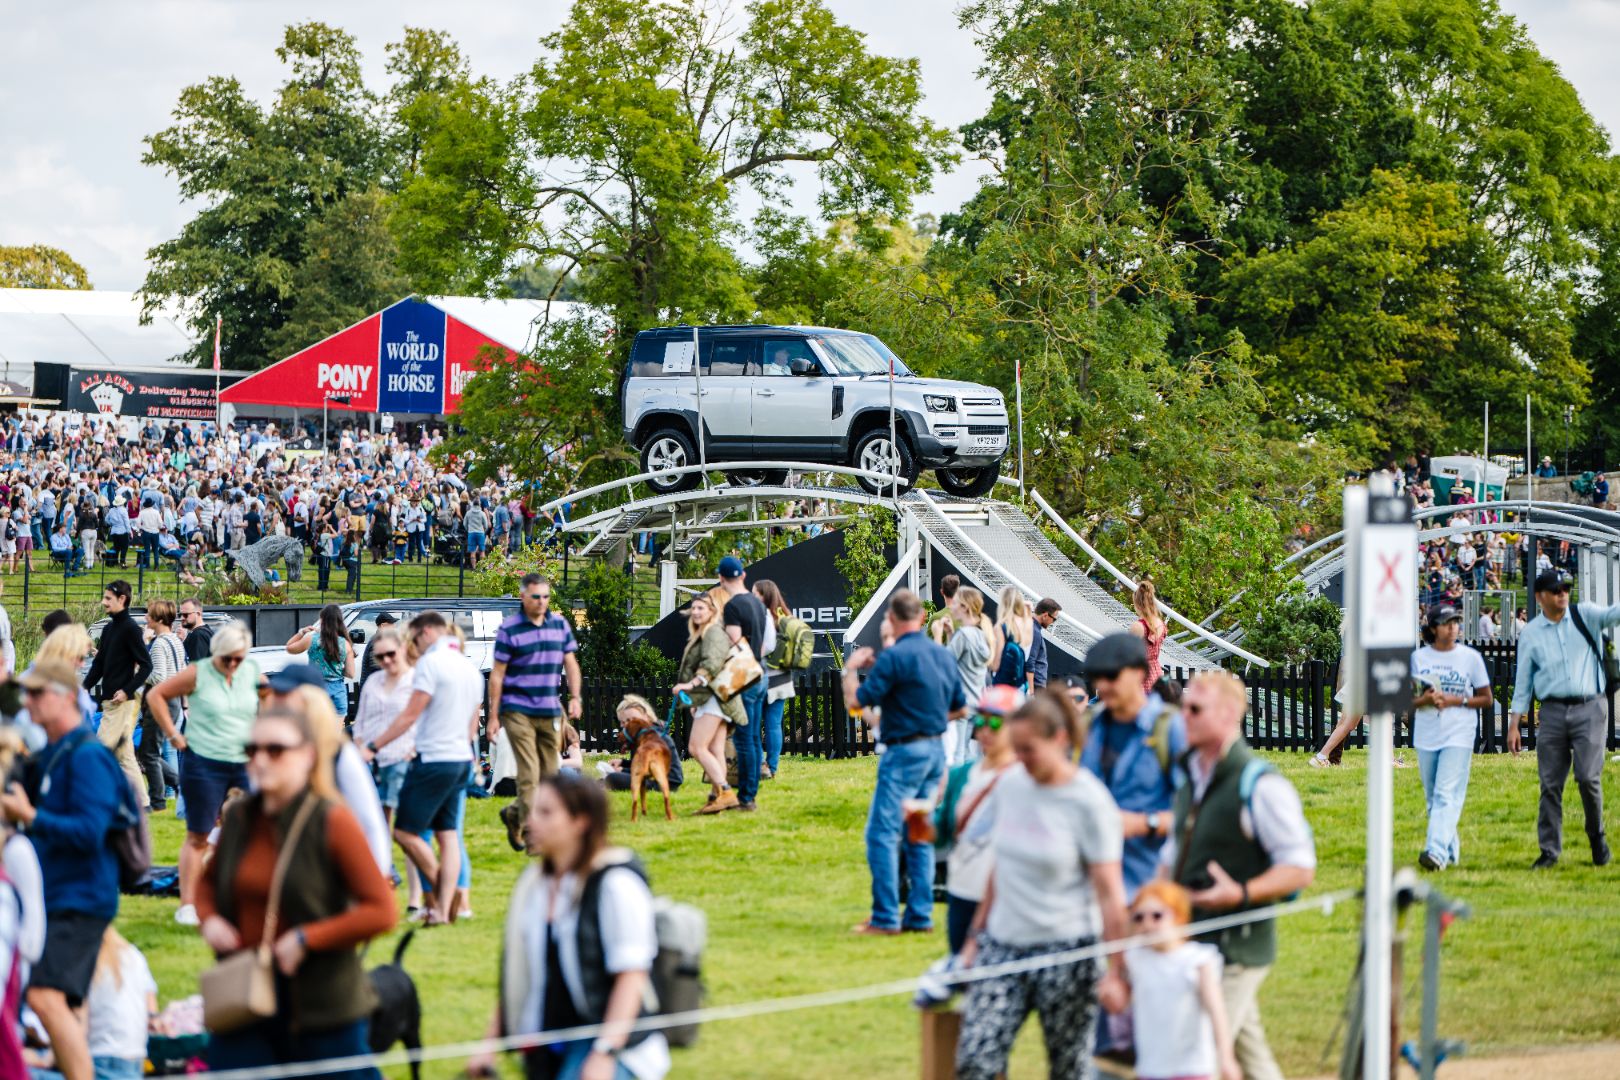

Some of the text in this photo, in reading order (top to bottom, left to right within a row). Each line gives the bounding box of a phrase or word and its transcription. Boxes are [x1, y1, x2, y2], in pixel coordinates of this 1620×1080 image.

[406, 330, 420, 343] The
[386, 342, 439, 361] WORLD
[401, 360, 422, 374] of the
[104, 372, 135, 395] AGES
[317, 363, 373, 391] PONY
[387, 374, 436, 393] HORSE
[99, 404, 113, 413] UK
